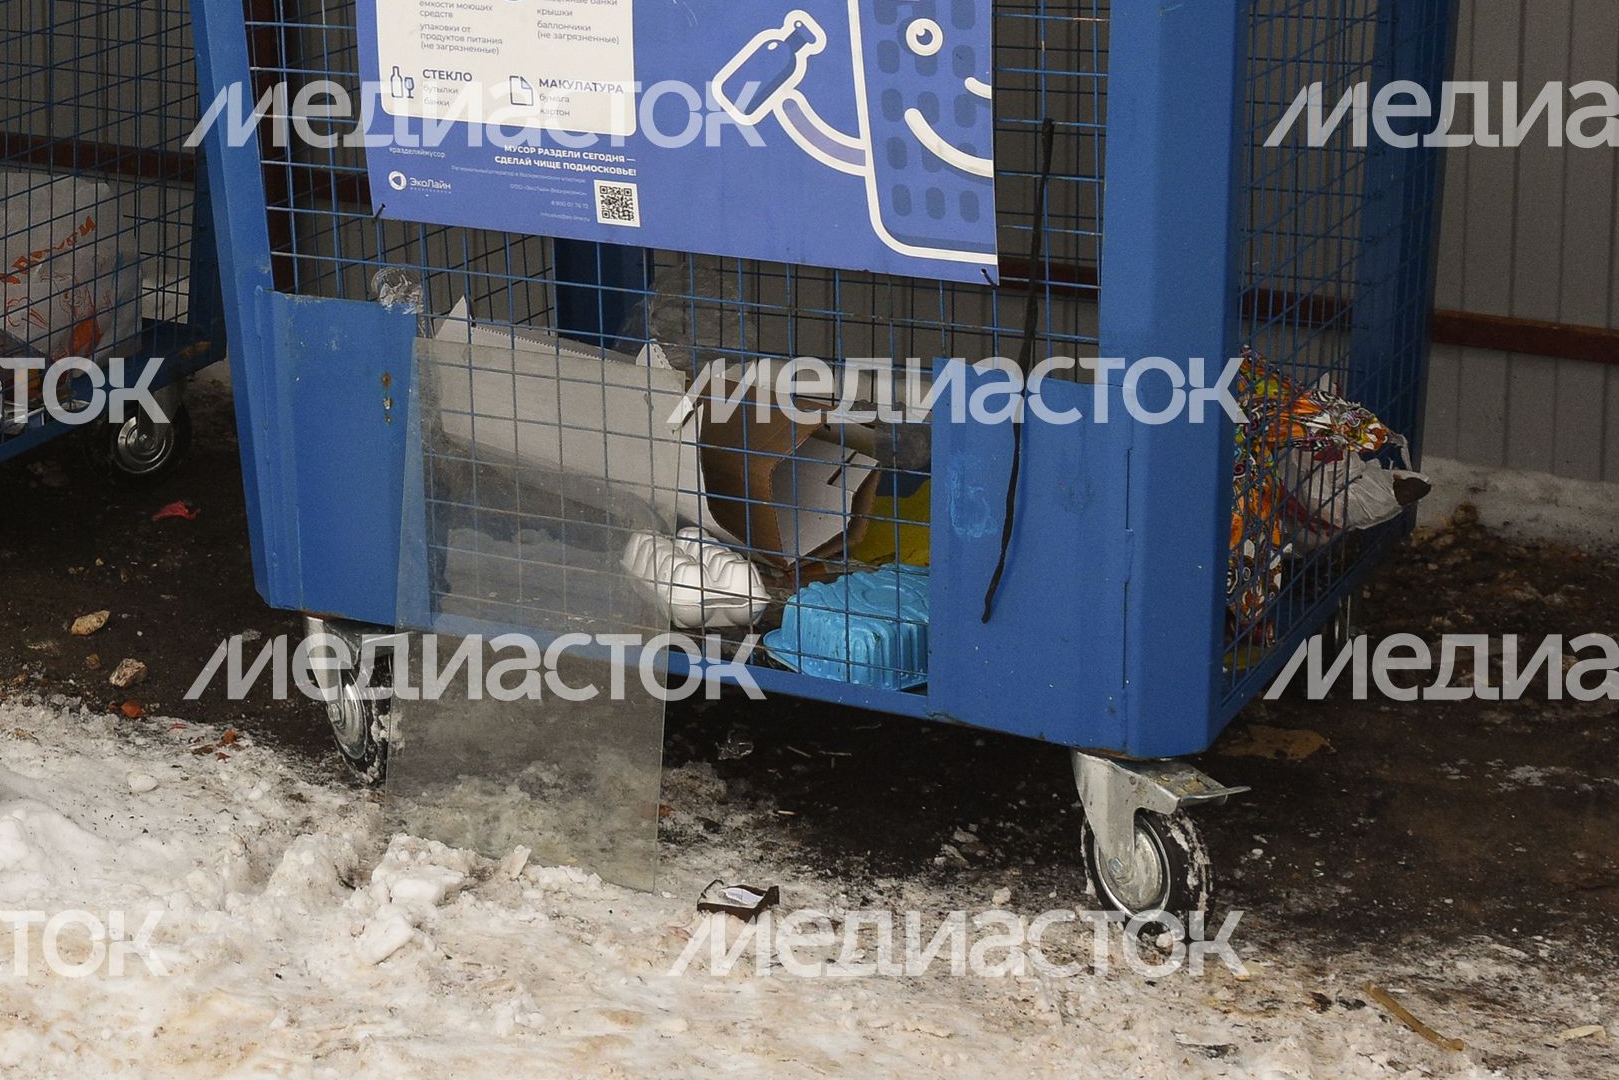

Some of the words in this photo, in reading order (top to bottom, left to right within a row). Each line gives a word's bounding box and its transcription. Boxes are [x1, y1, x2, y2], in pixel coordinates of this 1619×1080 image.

[419, 1, 455, 10] емкости
[457, 3, 493, 12] моющих
[537, 8, 573, 17] крышки
[419, 10, 454, 19] средств
[420, 23, 460, 33] упаковки
[537, 21, 591, 32] баллончики
[420, 33, 465, 44] продуктов
[466, 36, 503, 45] питания
[537, 30, 552, 40] (не
[554, 32, 620, 45] загрязненные)
[420, 42, 434, 51] (не
[436, 43, 500, 55] загрязненные)
[422, 69, 473, 82] СТЕКЛО
[423, 84, 459, 96] бутылки
[539, 78, 624, 94] МАКУЛАТУРА
[424, 97, 450, 107] банки
[539, 93, 570, 104] бумага
[540, 109, 570, 118] картон
[504, 144, 536, 154] МУСОР
[538, 147, 580, 159] РАЗДЕЛИ
[582, 151, 625, 163] СЕГОДНЯ
[494, 155, 532, 167] СДЕЛАЙ
[534, 159, 561, 170] ЧИЩЕ
[563, 162, 637, 176] ПОДМОСКОВЬЕ!
[409, 177, 452, 190] ЭкоЛайн
